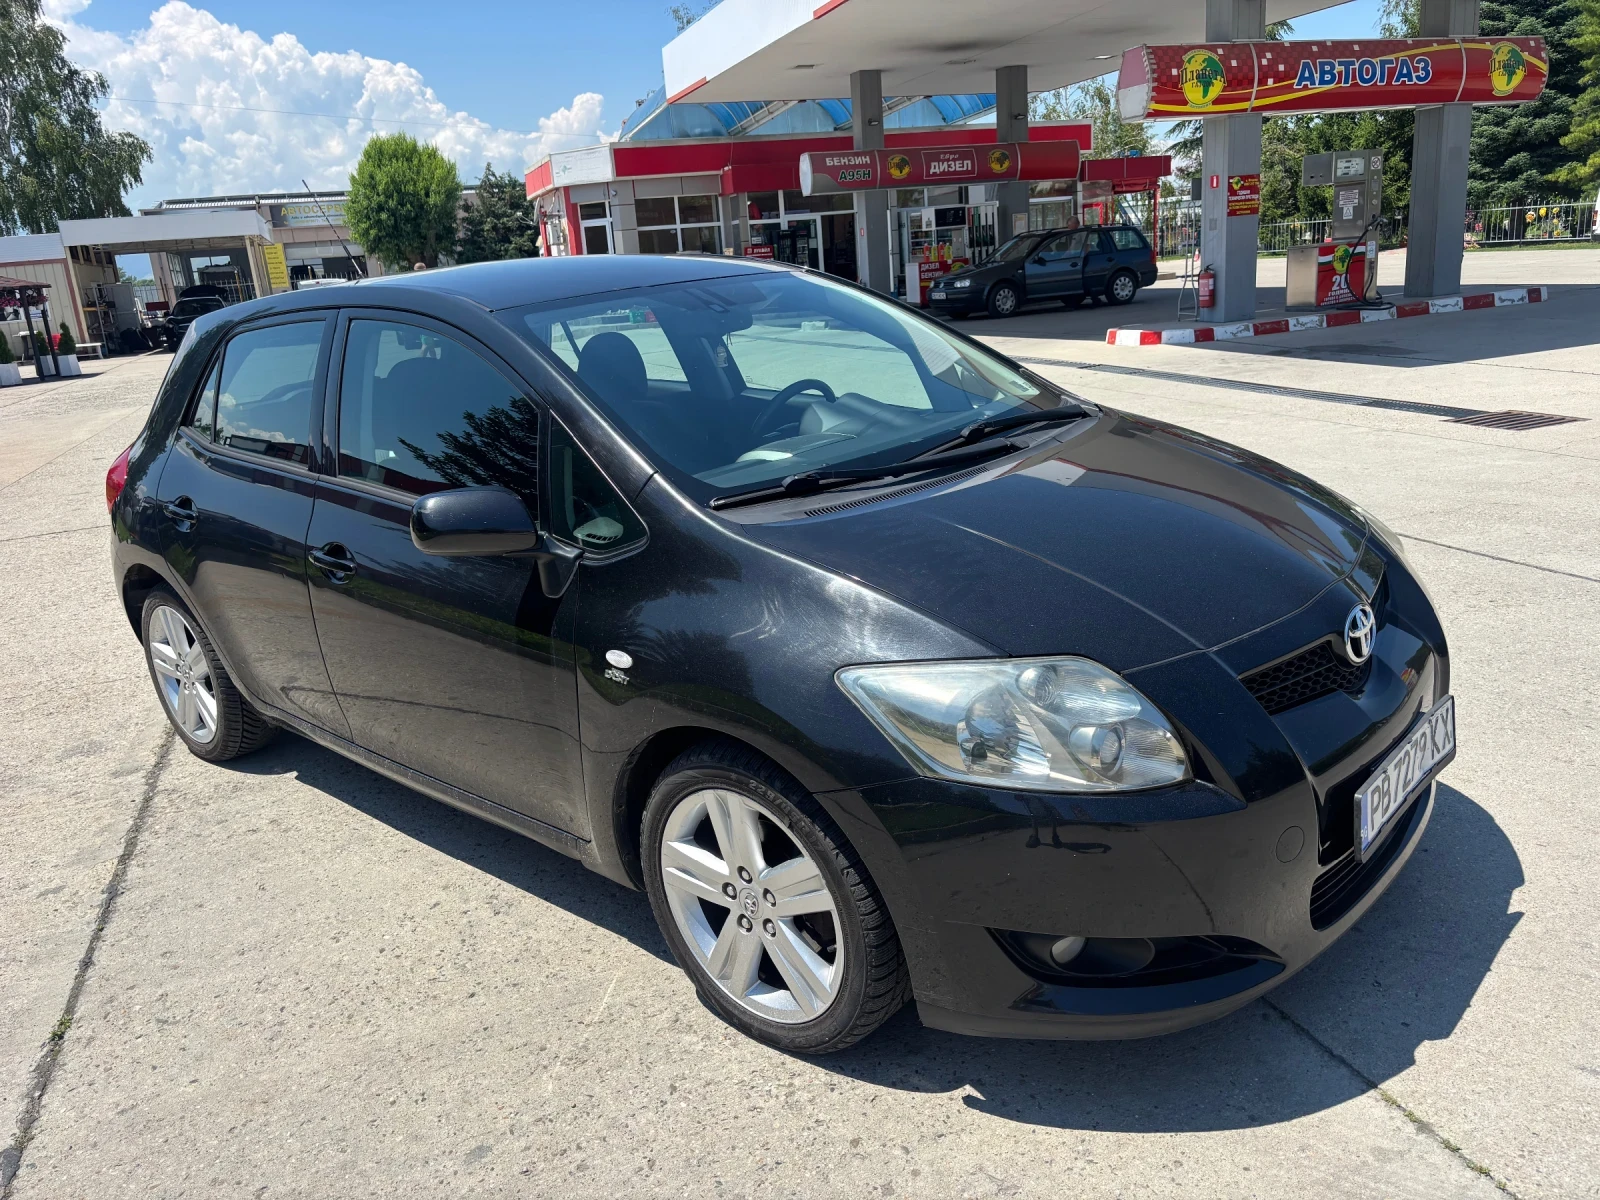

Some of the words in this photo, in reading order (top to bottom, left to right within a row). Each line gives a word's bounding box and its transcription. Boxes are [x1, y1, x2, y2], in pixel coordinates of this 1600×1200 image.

[1294, 56, 1432, 88] АВТОГАЗ
[825, 155, 870, 166] БЕНЗИН
[929, 160, 972, 175] ДИЗЕЛ
[1370, 773, 1391, 832] PB
[1393, 731, 1428, 805] 7279
